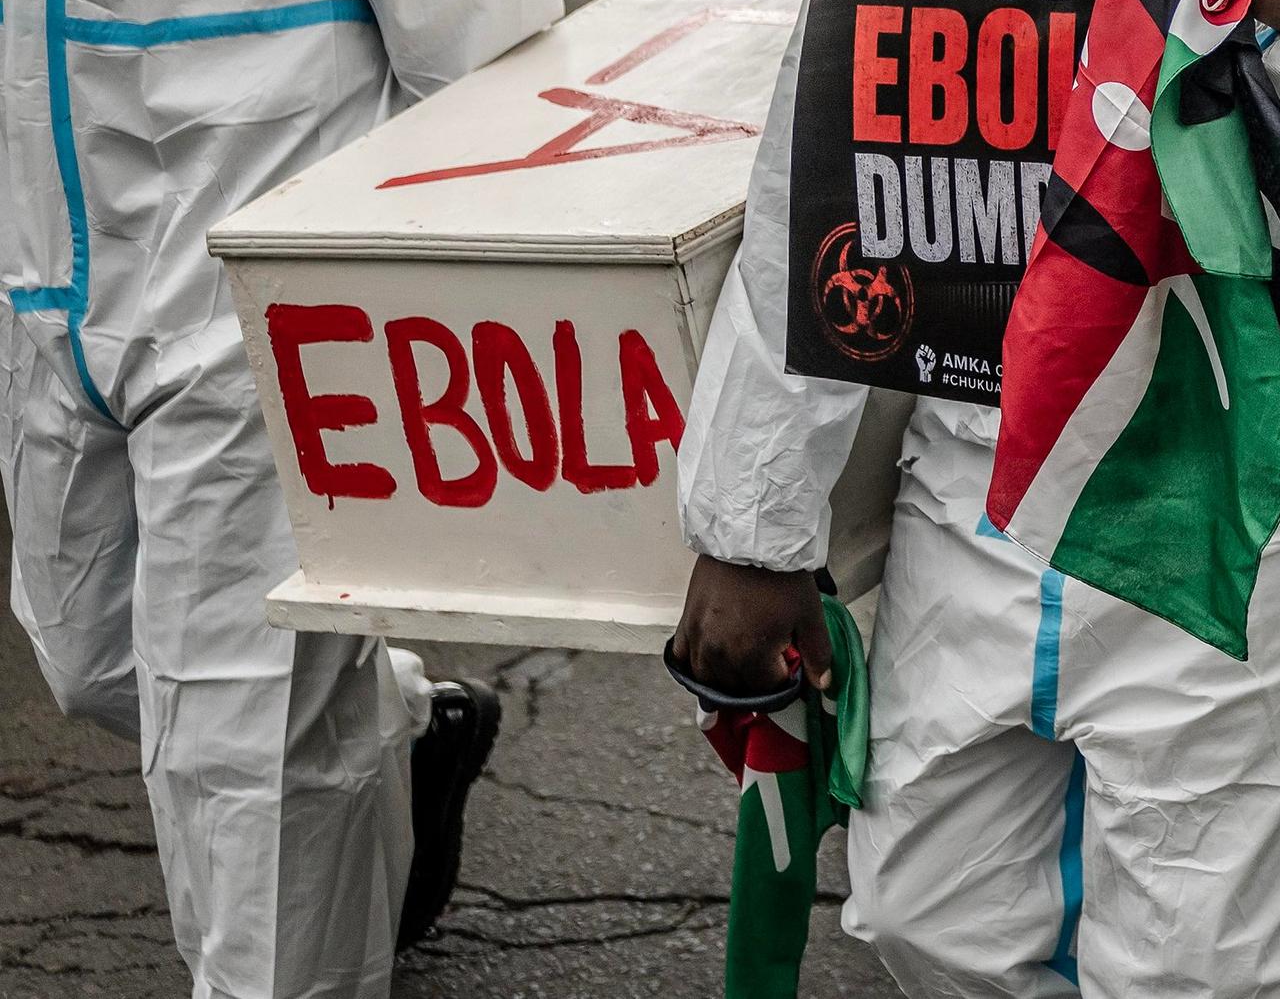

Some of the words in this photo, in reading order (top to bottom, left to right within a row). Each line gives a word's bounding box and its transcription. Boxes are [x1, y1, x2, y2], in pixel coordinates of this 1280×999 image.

[853, 153, 1054, 265] DUMP
[942, 353, 991, 375] AMKA
[942, 373, 1002, 393] #CHUKUA
[265, 303, 685, 509] EBOLA
